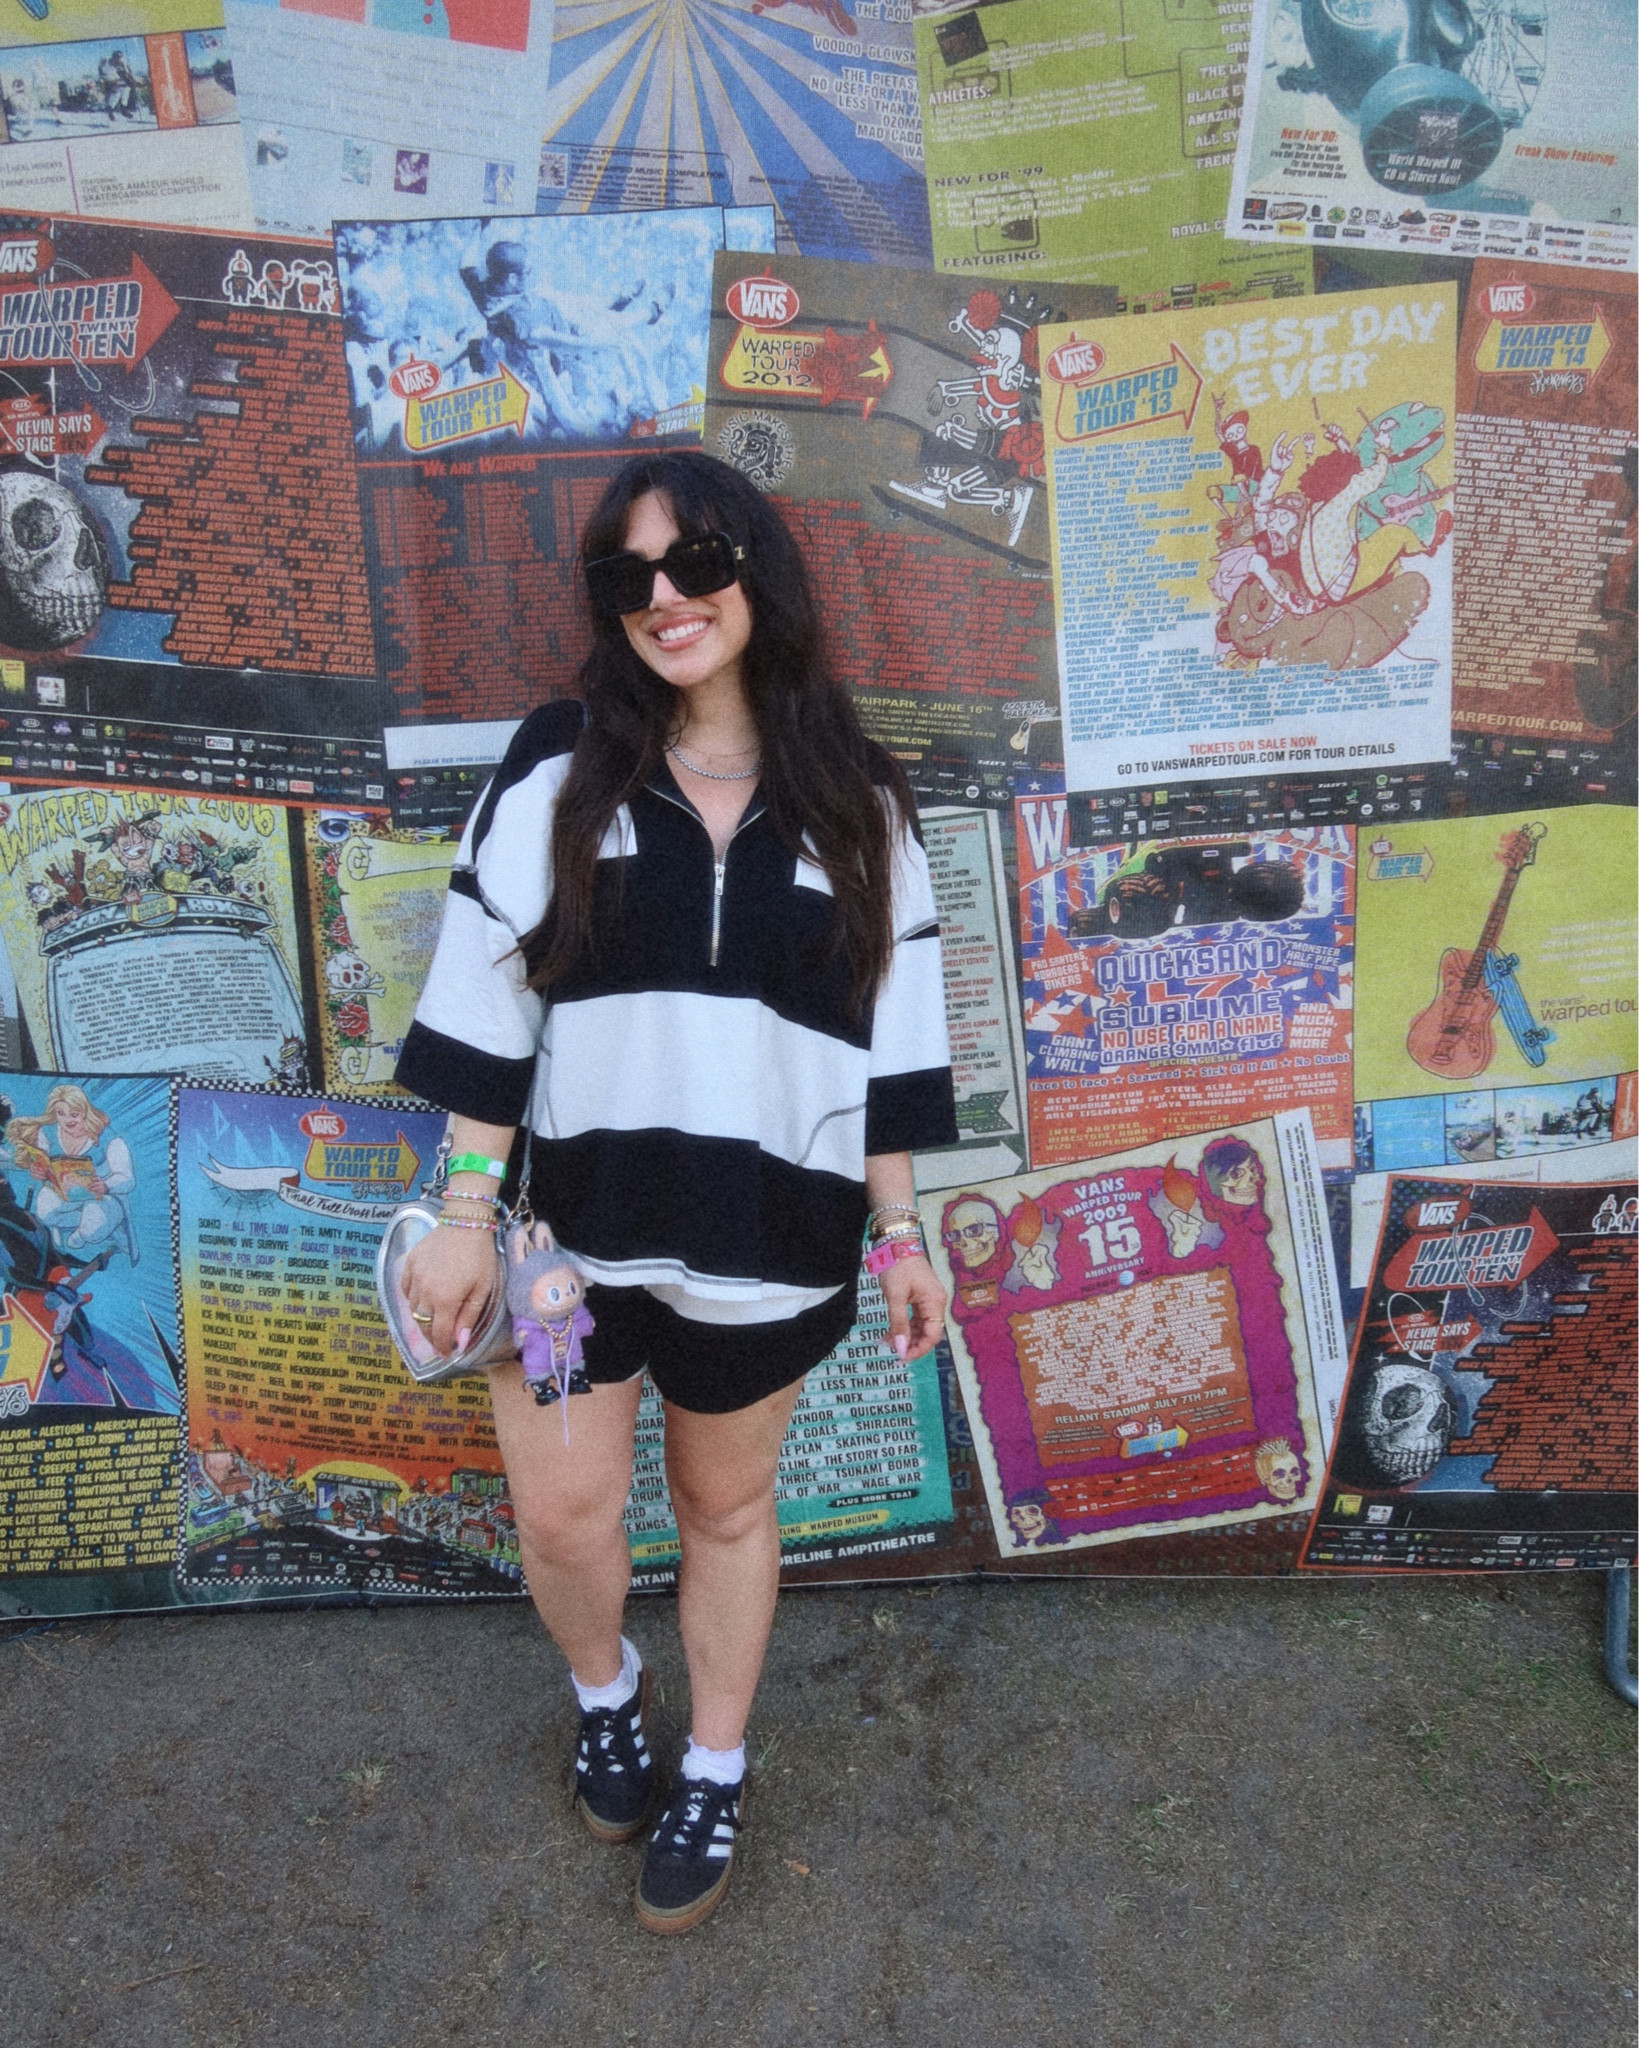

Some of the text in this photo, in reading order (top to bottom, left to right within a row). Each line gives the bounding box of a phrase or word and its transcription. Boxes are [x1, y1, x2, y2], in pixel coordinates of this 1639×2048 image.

[815, 38, 861, 56] VOODOO
[836, 81, 886, 97] USE FOR
[929, 87, 991, 105] ATHLETES:
[1187, 86, 1228, 104] BLACK
[839, 97, 906, 115] LESS THAN
[858, 125, 884, 139] MAD
[1515, 144, 1541, 157] Freak
[1388, 154, 1449, 169] World Warped
[935, 176, 972, 187] NEW
[979, 171, 1010, 182] FOR
[1409, 171, 1436, 183] Stores
[943, 252, 1047, 268] FEATURING:
[3, 281, 142, 328] WARPED
[740, 282, 788, 320] VANS
[1489, 285, 1526, 312] VANS
[79, 319, 138, 333] TWENTY
[1201, 300, 1445, 373] BEST DAY
[1500, 325, 1592, 347] WARPED
[78, 332, 136, 359] TEN
[742, 338, 815, 357] WARPED
[752, 356, 799, 371] TOUR
[1054, 344, 1097, 378] VANS
[1496, 347, 1587, 368] TOUR '14
[396, 364, 435, 394] VANS
[743, 371, 813, 387] 2012
[1233, 351, 1372, 408] EVER
[1077, 366, 1178, 412] WARPED
[420, 382, 507, 423] WARPED
[1074, 391, 1172, 435] TOUR '13
[16, 414, 91, 436] KEVIN SAYS
[420, 412, 473, 443] TOUR
[16, 436, 56, 453] STAGE
[1577, 463, 1623, 473] YELLOWCARD
[1189, 736, 1318, 755] TICKETS ON SALE NOW
[1118, 743, 1395, 775] GO TO VANSWARPEDTOUR.COM FOR TOUR DETAILS
[0, 789, 108, 877] WARPED
[1287, 951, 1340, 966] HALF PIPE
[1292, 943, 1340, 956] MONSTER
[1099, 940, 1281, 991] QUICKSAND
[1045, 974, 1082, 990] BIKERS
[1147, 973, 1242, 1004] L7
[1101, 991, 1281, 1030] SUBLIME
[1300, 1003, 1331, 1014] AND,
[1542, 1000, 1610, 1022] warped
[1293, 1015, 1338, 1027] MUCH,
[1103, 1014, 1282, 1049] NO USE FOR A NAME
[1291, 1027, 1332, 1038] MUCH
[1052, 1035, 1095, 1049] GIANT
[1102, 1033, 1283, 1064] ORANGE 9MM fluf
[1289, 1038, 1328, 1048] MORE
[1039, 1045, 1099, 1061] CLIMBING
[1031, 1053, 1349, 1091] face to face Seaweed Sick Of It All No Doubt
[1045, 1057, 1087, 1073] WALL
[308, 1115, 339, 1135] VANS
[324, 1147, 400, 1162] WARPED
[325, 1162, 371, 1177] TOUR
[1074, 1177, 1124, 1200] VANS
[1063, 1192, 1142, 1218] WARPED TOUR
[1418, 1201, 1460, 1226] VANS
[1084, 1204, 1127, 1226] 2009
[301, 1226, 341, 1239] THE AMITY
[1078, 1216, 1142, 1267] 15
[1416, 1226, 1534, 1263] WARPED
[1085, 1257, 1144, 1278] ANNIVERSARY
[1477, 1253, 1526, 1265] TWENTY
[284, 1273, 326, 1285] DAYSEEKER
[1405, 1259, 1472, 1288] TOUR
[1473, 1262, 1522, 1283] TEN
[1406, 1322, 1471, 1339] KEVIN SAYS
[1403, 1339, 1437, 1350] STAGE
[821, 1372, 909, 1390] LESS THAN JAKE
[836, 1388, 911, 1404] NOFX OFF!
[850, 1402, 912, 1417] QUICKSAND
[1055, 1388, 1227, 1424] RELIANT STADIUM JULY 7TH 7PM
[39, 1417, 178, 1437] ALESTORM AMERICAN AUTHORS
[856, 1417, 915, 1431] SHIRAGIRL
[795, 1431, 916, 1455] PLAN SKATING POLLY
[825, 1445, 917, 1466] THE STORY FAR
[39, 1459, 113, 1475] CREEPER DANCE
[780, 1458, 919, 1485] THRICE TSUNAMI BOMB
[862, 1472, 921, 1489] WAGE WAR
[76, 1520, 132, 1532] SEPARATIONS
[811, 1513, 878, 1531] WARPED MUSEUM
[838, 1533, 935, 1557] AMPITHEATRE
[16, 1555, 126, 1572] WATSKY WHITE NOISE
[30, 1549, 55, 1560] SYLAR
